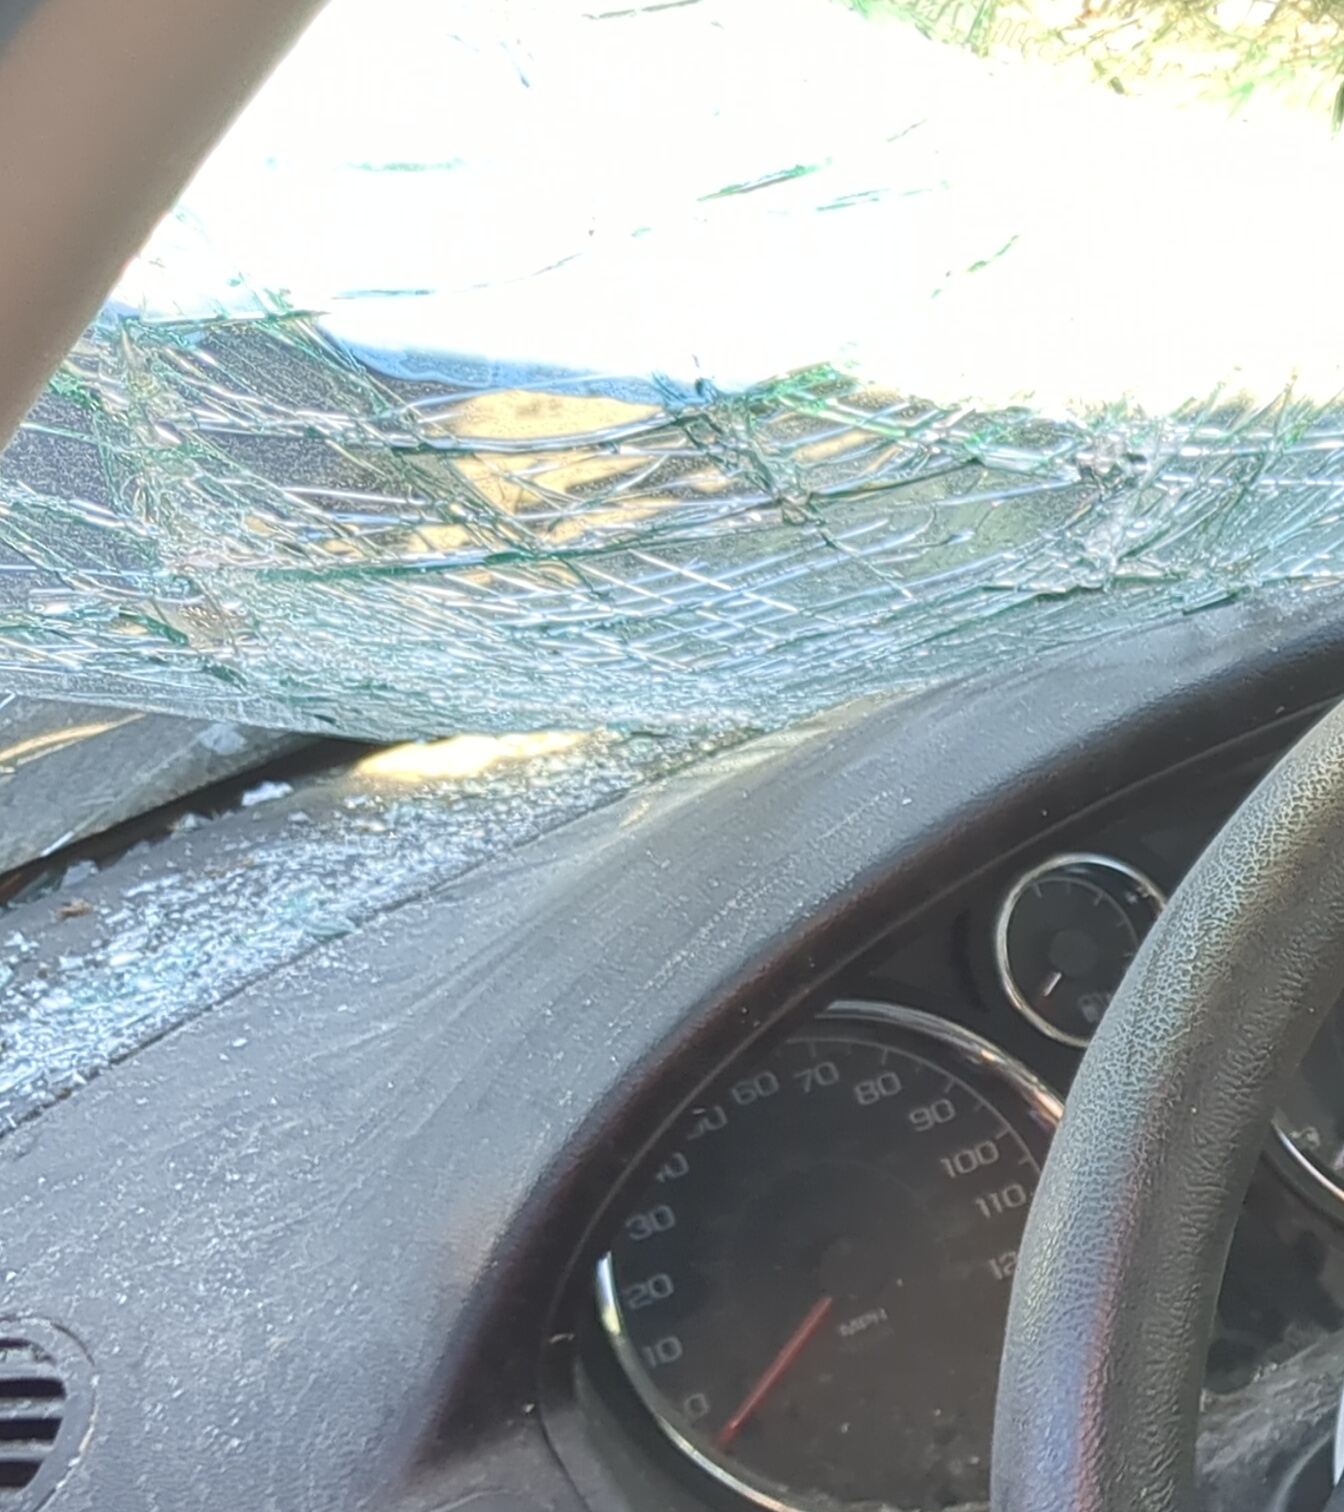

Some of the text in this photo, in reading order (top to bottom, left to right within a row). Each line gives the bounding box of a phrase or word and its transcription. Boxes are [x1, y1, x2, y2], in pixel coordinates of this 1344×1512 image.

[731, 1071, 779, 1105] 60
[794, 1061, 839, 1093] 70
[854, 1072, 902, 1105] 80
[908, 1099, 956, 1132] 90
[940, 1140, 999, 1178] 100
[975, 1183, 1027, 1218] 110
[625, 1204, 676, 1241] 30
[988, 1251, 1017, 1281] 12
[622, 1273, 674, 1310] 20
[838, 1308, 888, 1338] MPH
[641, 1335, 683, 1368] 10
